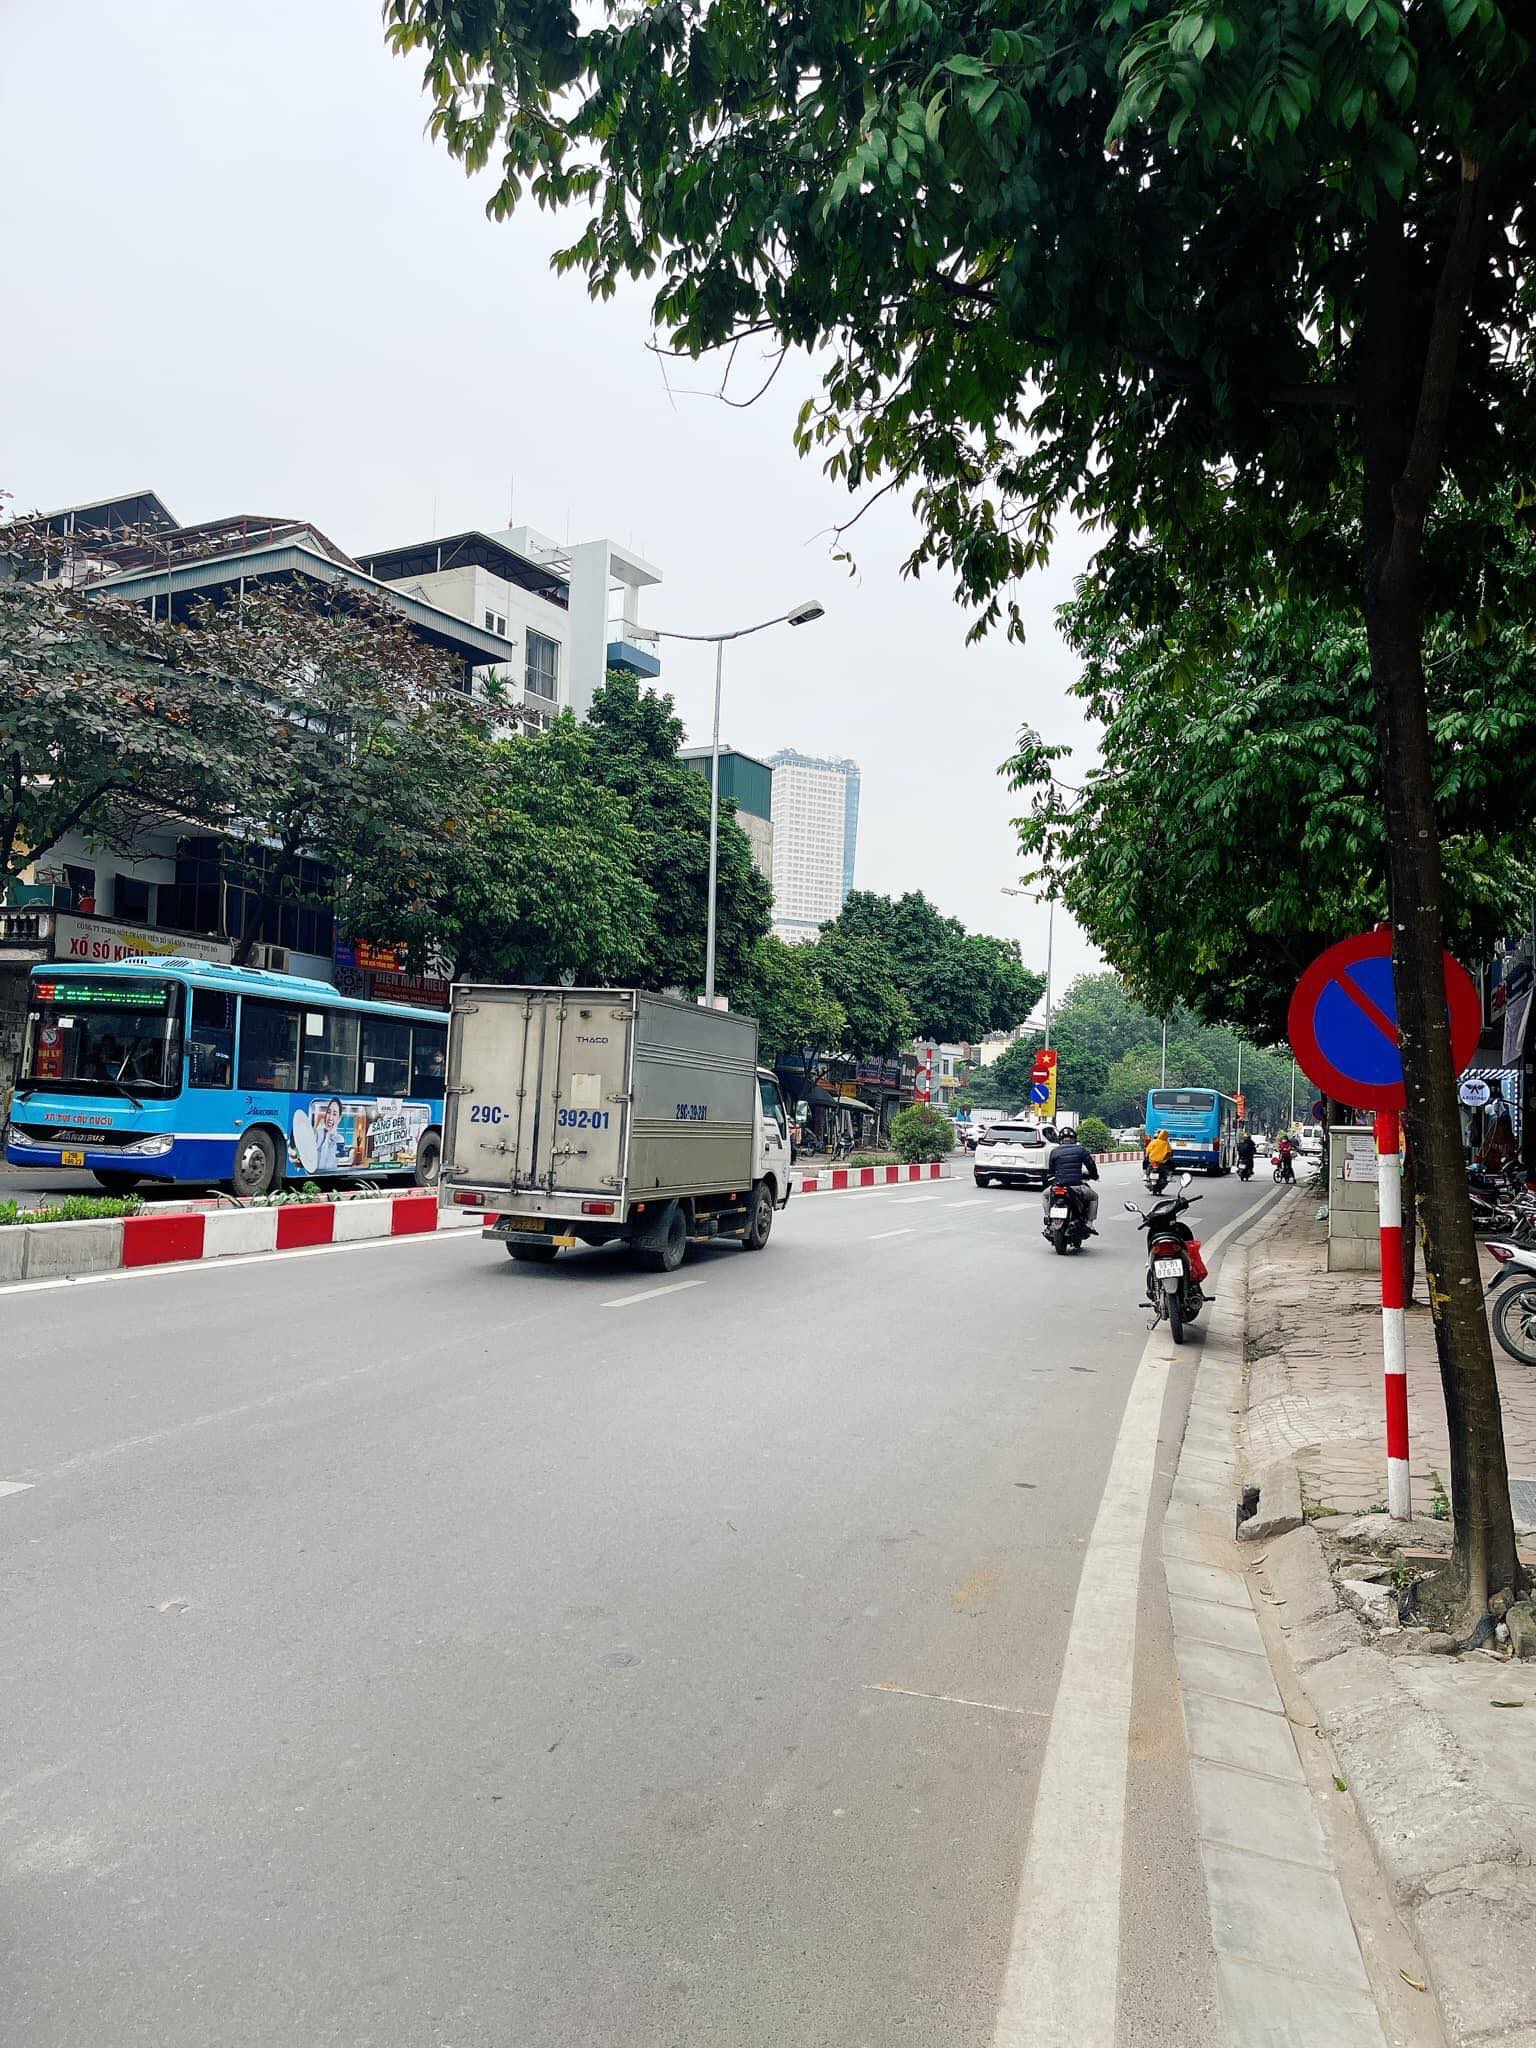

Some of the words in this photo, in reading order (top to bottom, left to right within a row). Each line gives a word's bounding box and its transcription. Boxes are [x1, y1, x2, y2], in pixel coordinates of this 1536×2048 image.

[70, 933, 89, 956] XỔ
[92, 938, 111, 960] SỐ
[576, 1036, 608, 1044] THACO
[470, 1105, 509, 1124] 29C-
[558, 1108, 609, 1129] 392-01
